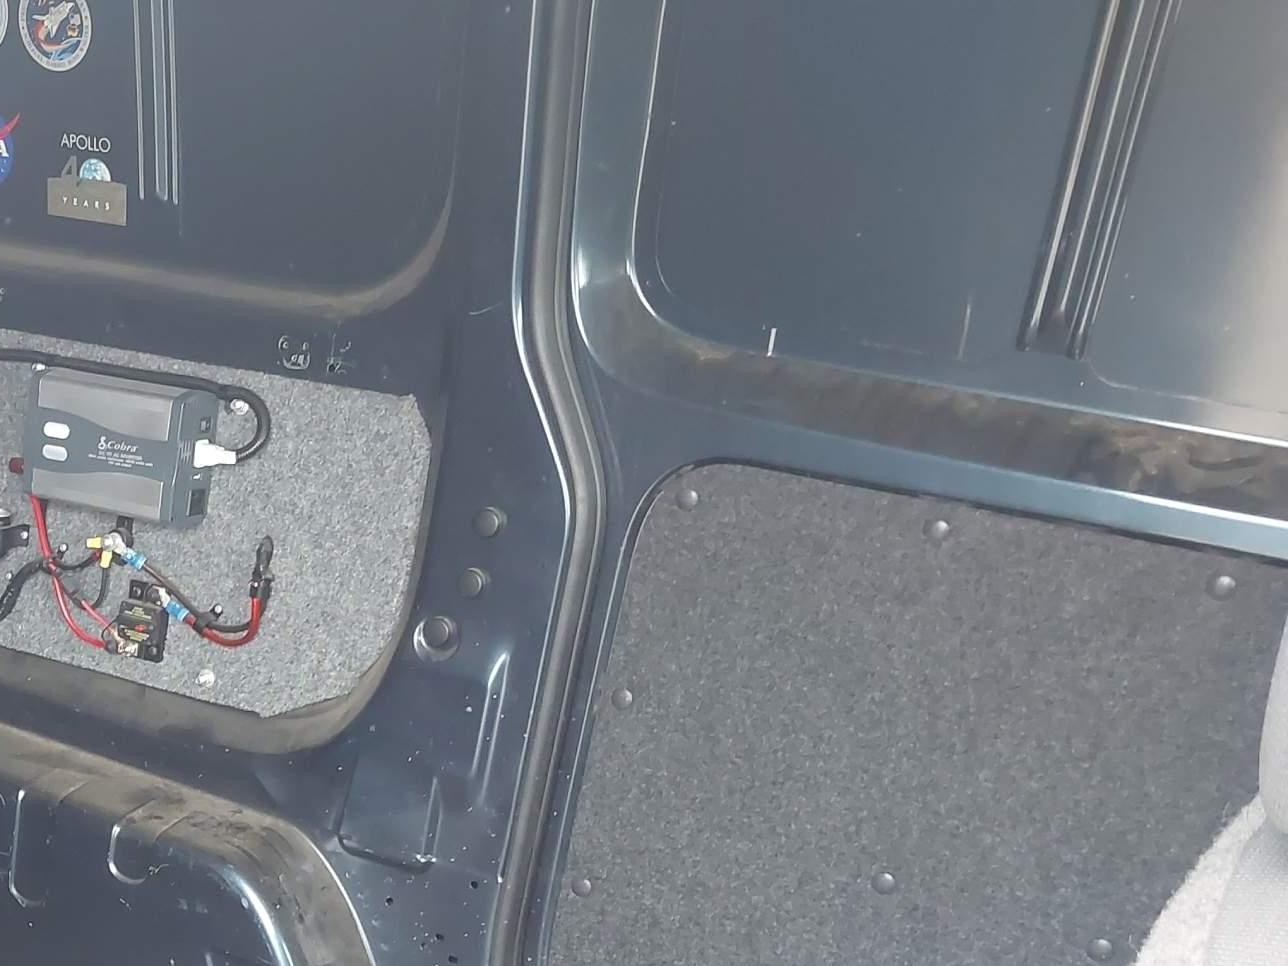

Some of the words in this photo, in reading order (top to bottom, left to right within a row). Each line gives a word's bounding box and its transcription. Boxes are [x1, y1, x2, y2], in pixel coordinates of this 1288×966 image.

[60, 132, 111, 153] APOLLO
[62, 196, 110, 211] YEARS
[107, 440, 138, 453] Cobra
